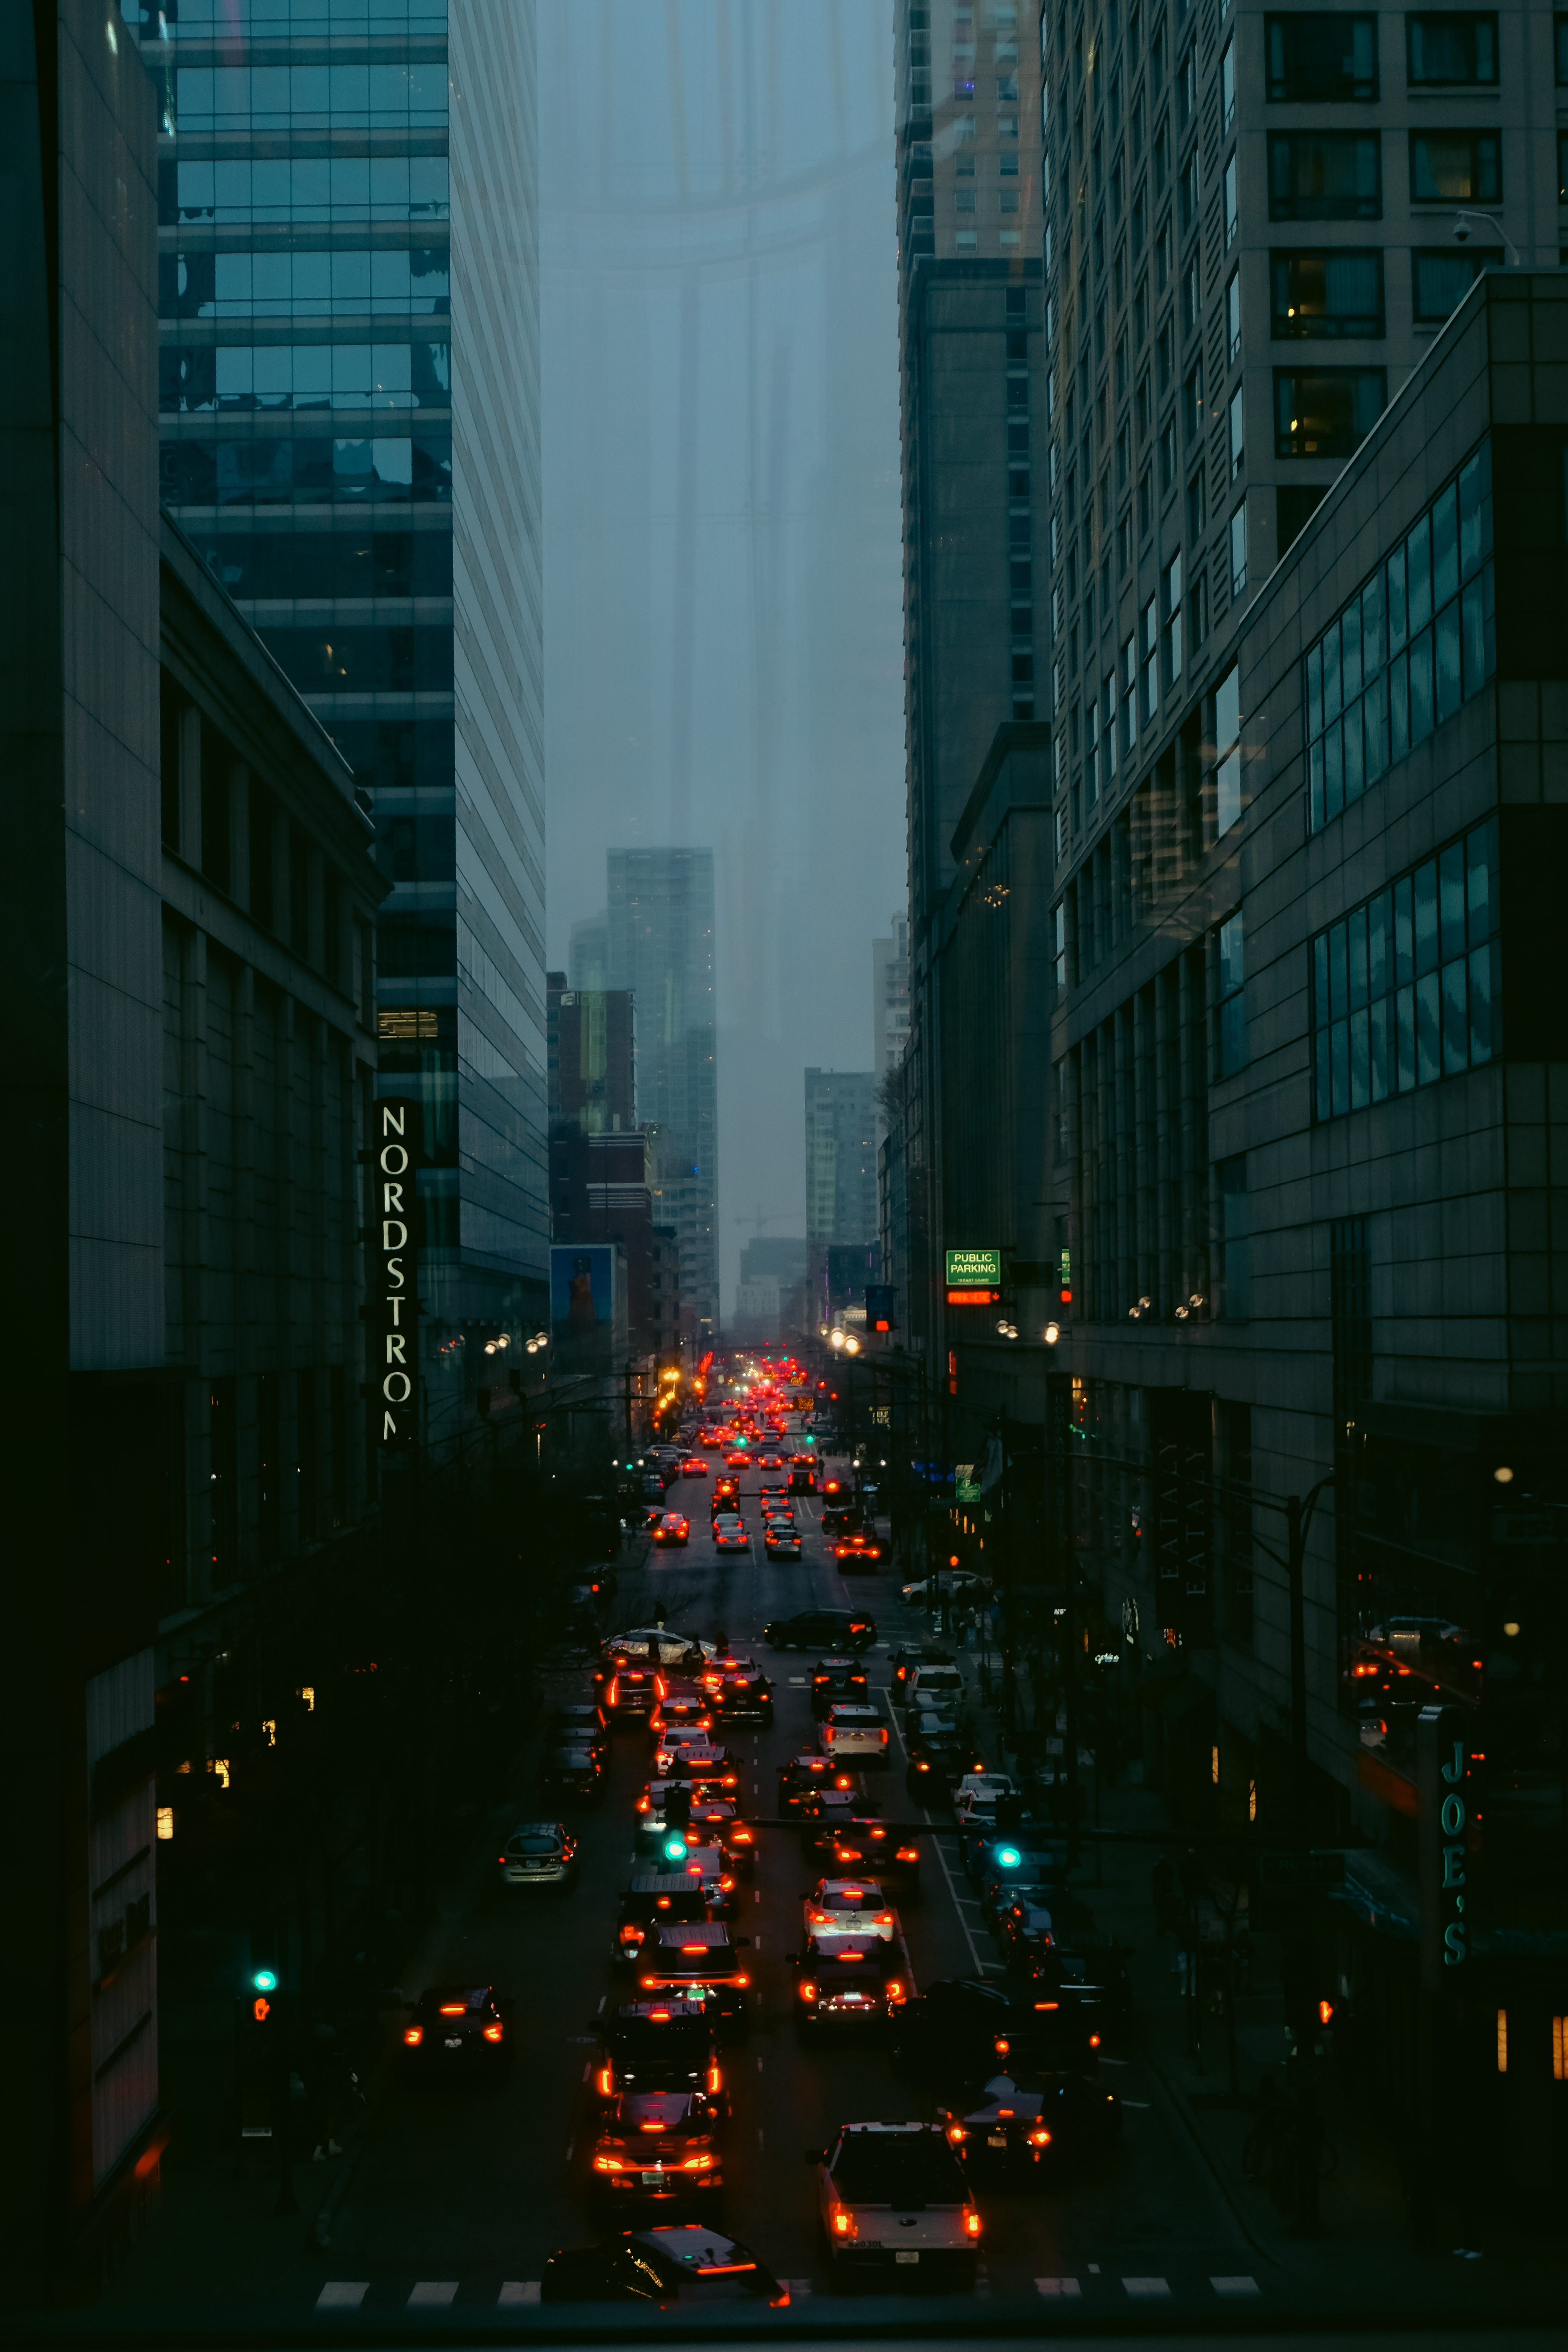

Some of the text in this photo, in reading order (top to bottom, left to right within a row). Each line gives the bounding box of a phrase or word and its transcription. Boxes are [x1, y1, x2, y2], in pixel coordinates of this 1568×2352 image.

[951, 1264, 996, 1273] PARKING
[954, 1253, 992, 1263] PUBLIC
[1159, 1438, 1179, 1580] EATALY
[1185, 1445, 1206, 1597] EATALY
[1279, 1859, 1323, 1870] RUSH
[1441, 1740, 1466, 1966] JOE'S
